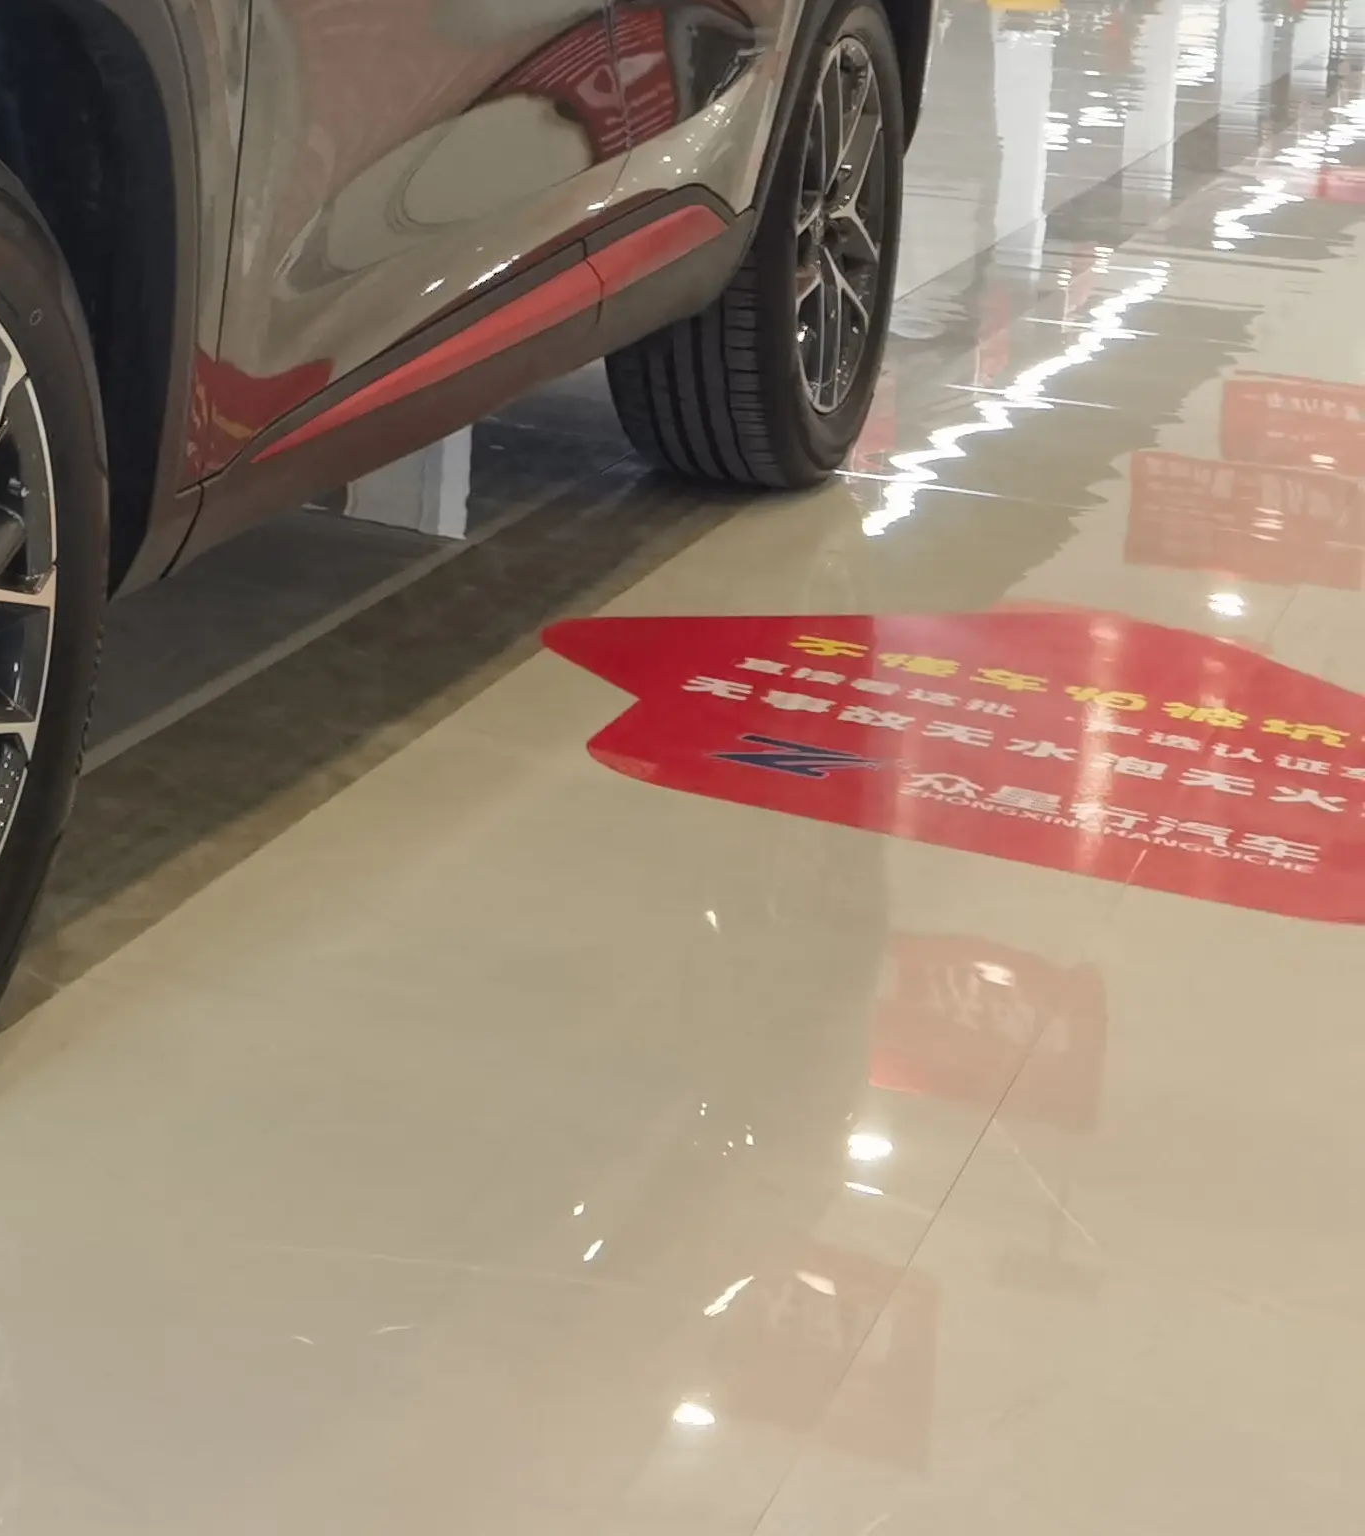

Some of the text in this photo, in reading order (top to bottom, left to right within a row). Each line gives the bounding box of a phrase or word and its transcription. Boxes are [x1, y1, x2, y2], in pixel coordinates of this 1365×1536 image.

[680, 675, 1365, 817] 无事故无水泡无火
[789, 635, 1351, 749] 不懂车怕被坑
[904, 772, 1321, 862] 众星行汽车
